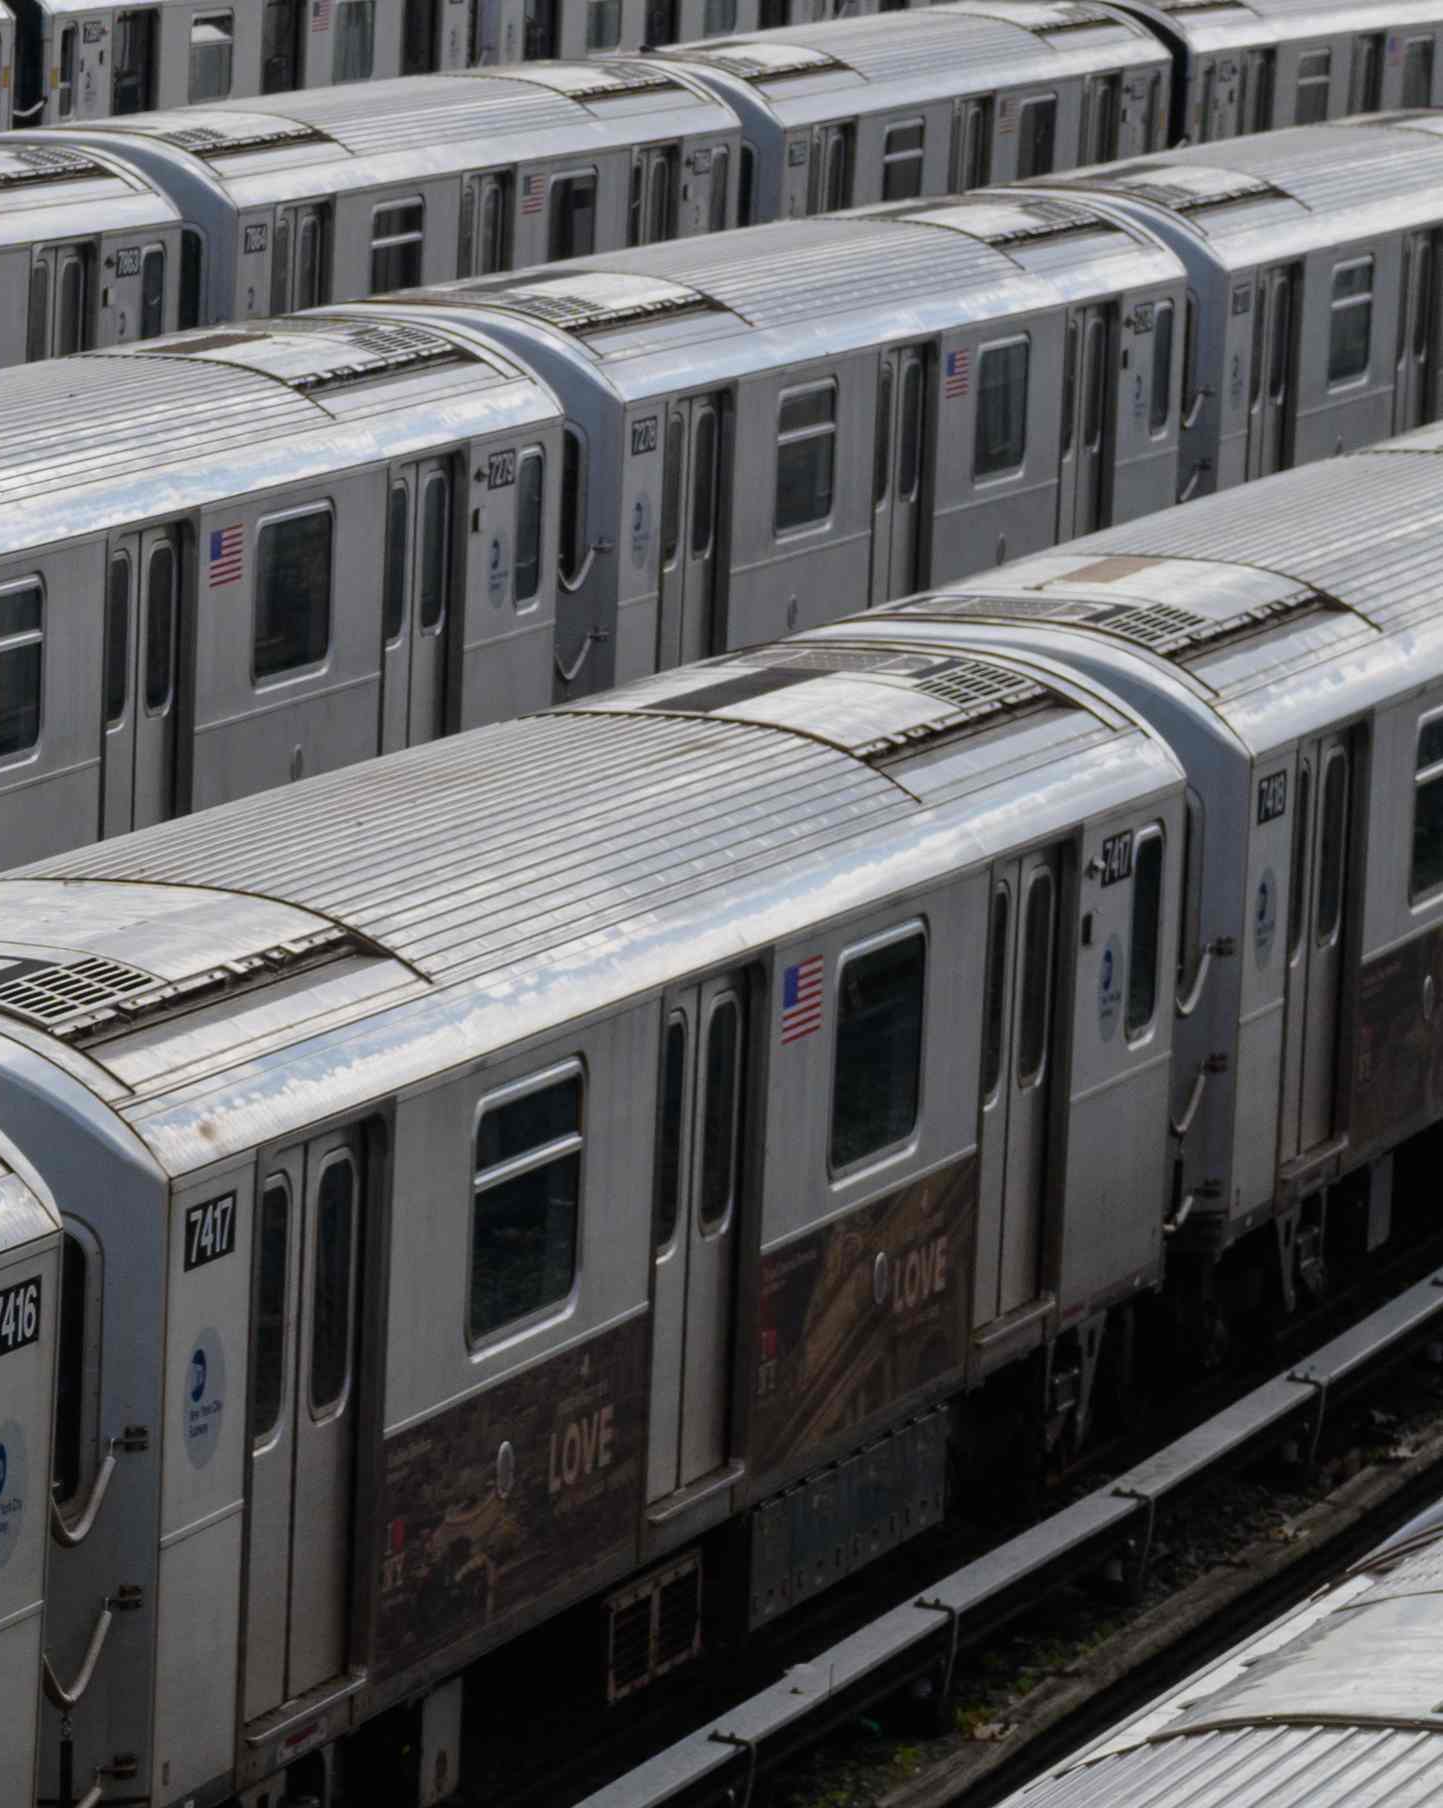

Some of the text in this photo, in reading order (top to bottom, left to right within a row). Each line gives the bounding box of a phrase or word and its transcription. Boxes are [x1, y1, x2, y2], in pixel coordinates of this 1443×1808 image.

[190, 1199, 232, 1264] 7417
[891, 1235, 948, 1313] LOVE
[549, 1405, 616, 1493] LOVE
